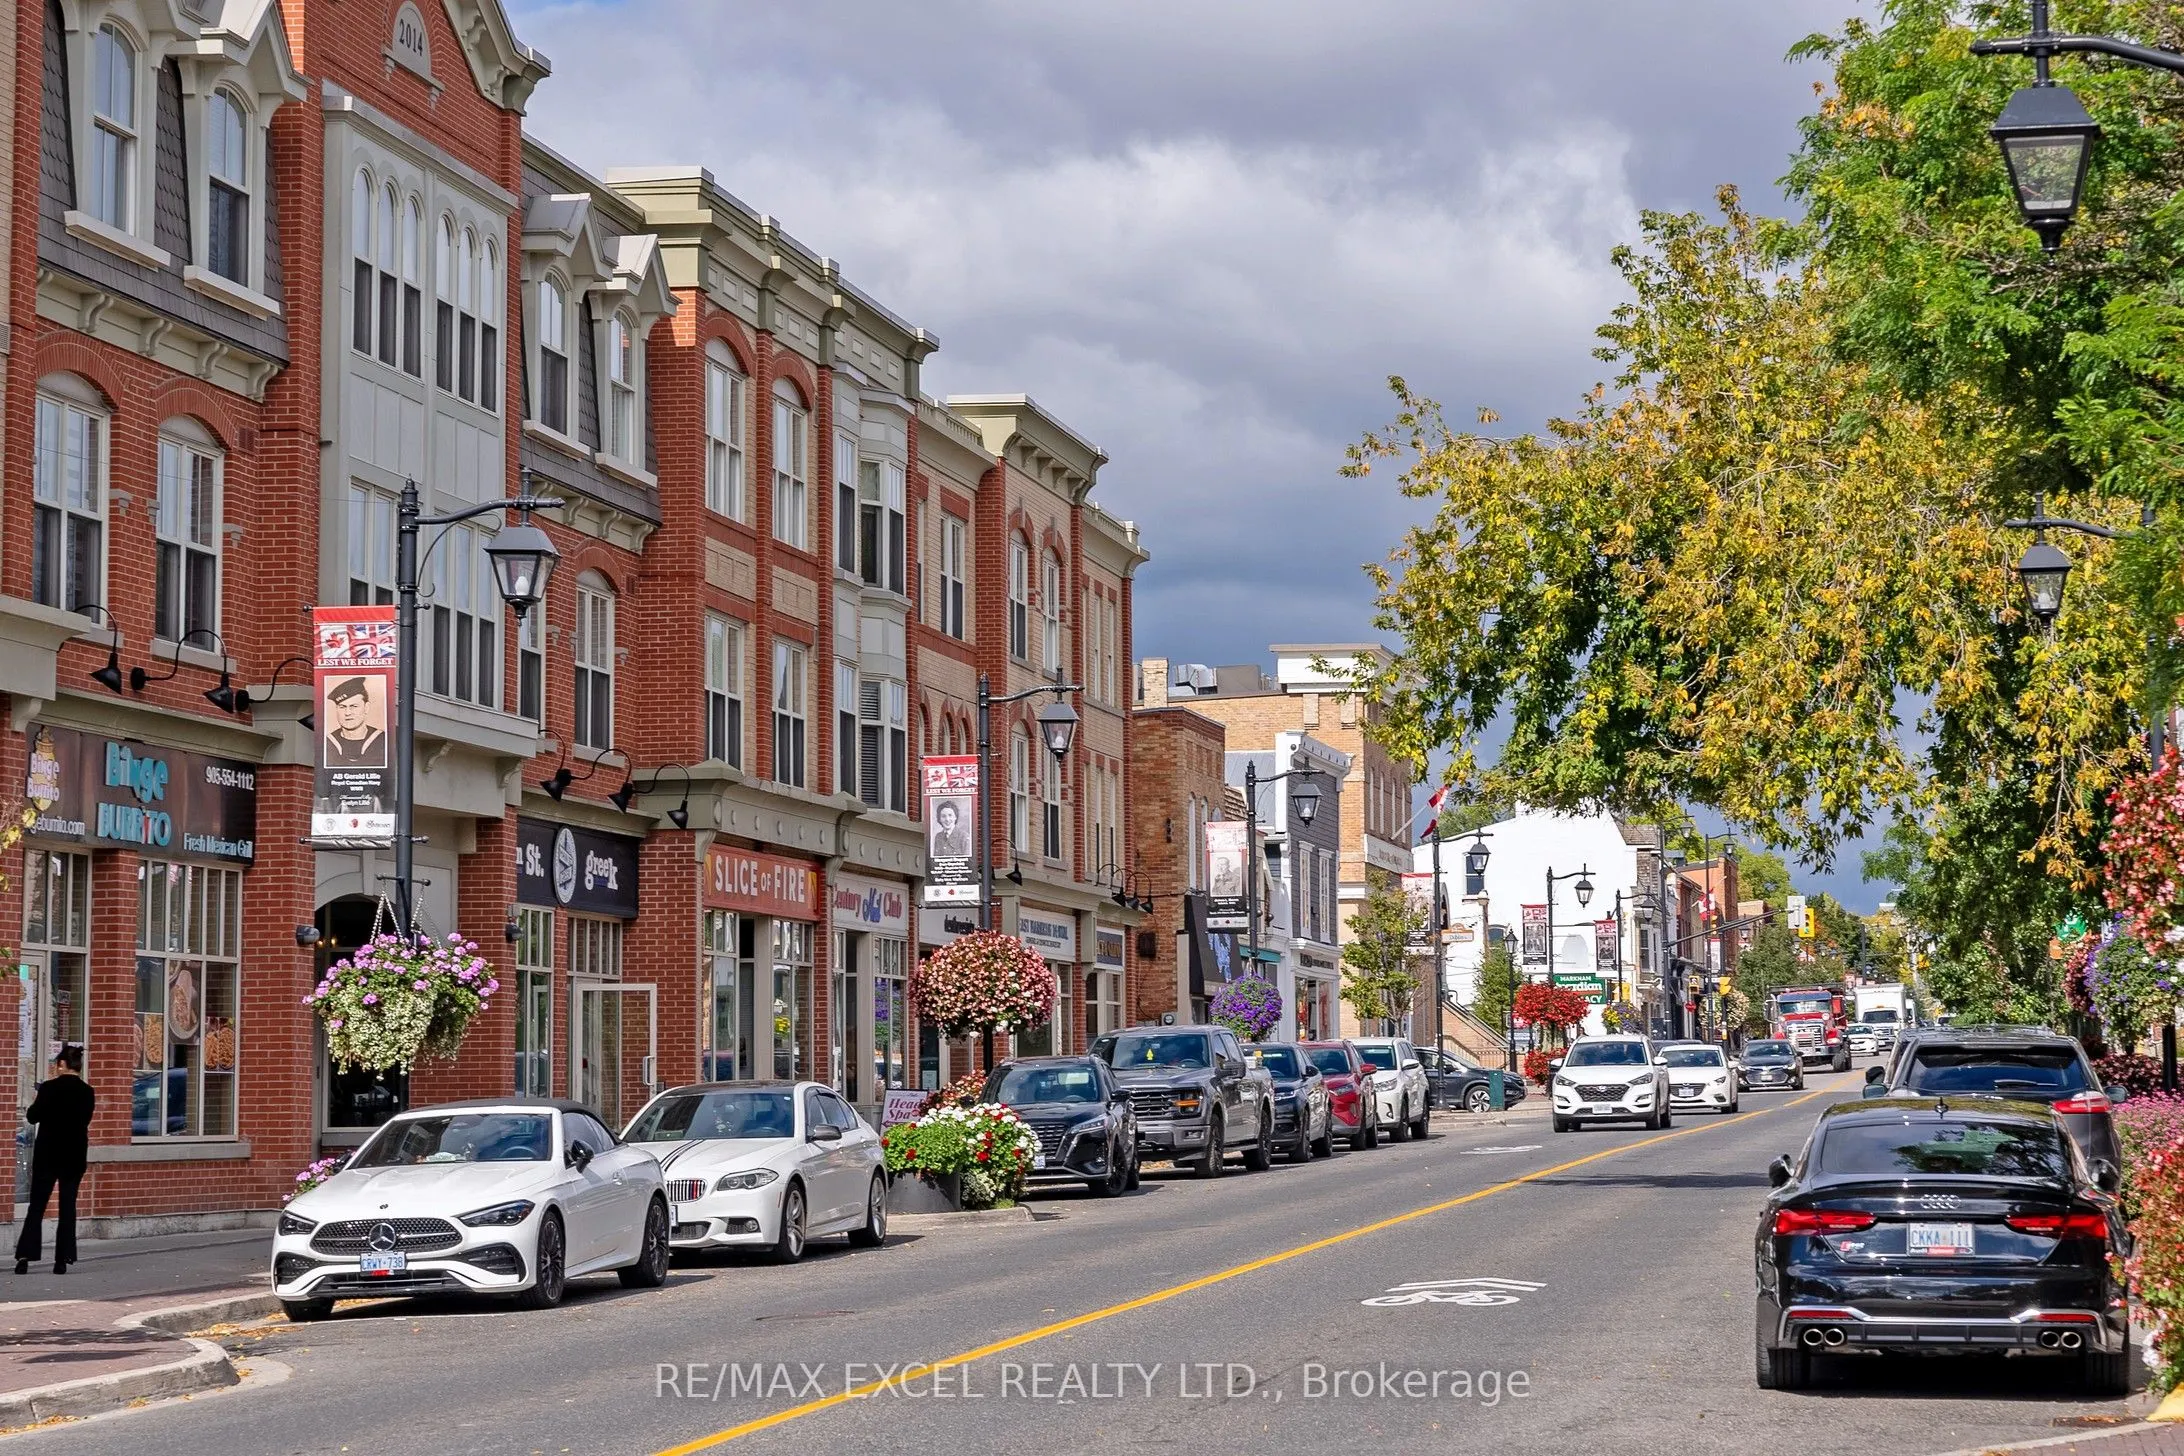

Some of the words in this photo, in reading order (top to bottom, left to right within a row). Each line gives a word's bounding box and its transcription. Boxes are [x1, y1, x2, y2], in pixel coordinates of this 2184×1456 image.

[399, 18, 423, 56] 2014
[317, 658, 339, 666] LEST
[340, 658, 357, 666] WE
[357, 657, 393, 666] FORGET
[30, 752, 60, 781] Binge
[105, 740, 168, 803] Binge
[205, 766, 254, 791] 905-554-1112
[26, 776, 60, 802] Burrito
[97, 802, 171, 846] BURRITO
[184, 832, 206, 851] Fresh
[206, 835, 236, 856] Mexican
[237, 839, 253, 859] Grill
[525, 842, 545, 878] St.
[584, 849, 619, 891] greek
[715, 854, 758, 897] SLICE
[774, 864, 805, 904] FIRE
[883, 891, 902, 919] Club
[889, 1109, 911, 1121] Spa
[1911, 1230, 1940, 1246] CKKA
